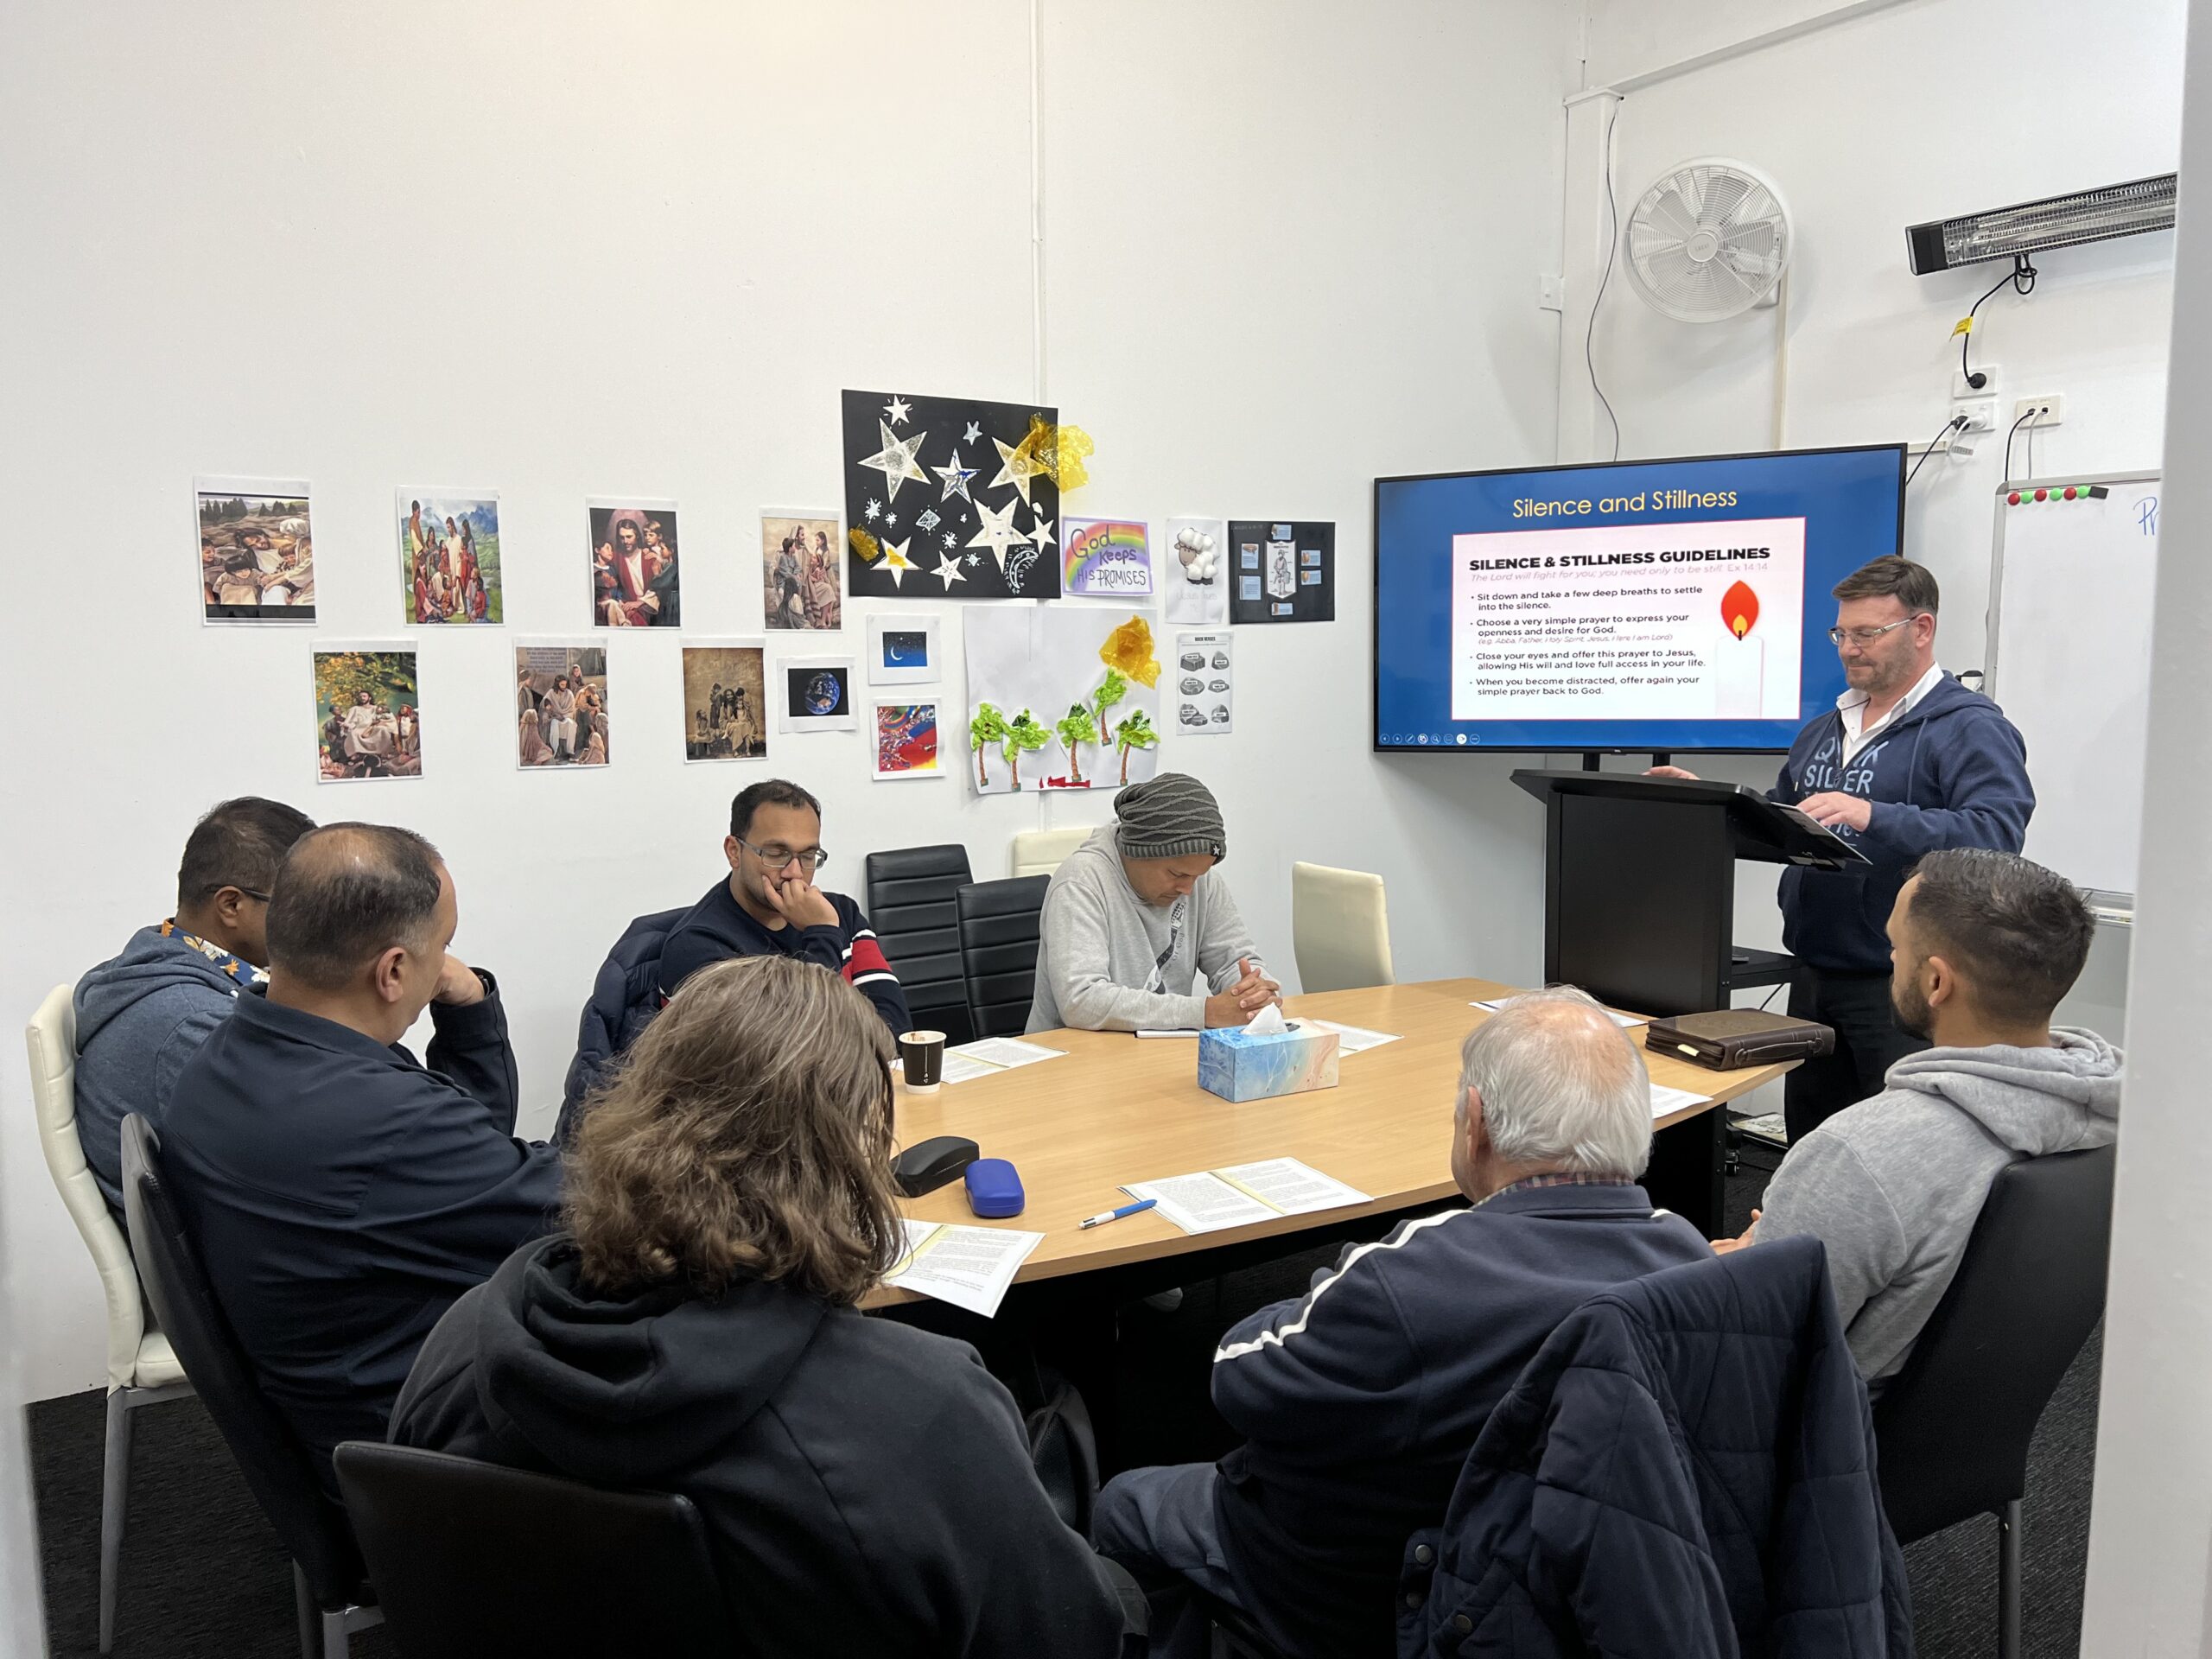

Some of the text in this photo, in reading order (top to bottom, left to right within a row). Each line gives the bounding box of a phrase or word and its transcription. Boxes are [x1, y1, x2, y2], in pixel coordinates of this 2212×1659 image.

[1513, 490, 1738, 518] Silence and Stillness
[1071, 524, 1116, 561] God
[1469, 548, 1770, 570] SILENCE & STILLNESS GUIDELINES
[1096, 569, 1146, 588] PROMISES
[1491, 573, 1513, 582] Lord
[1533, 571, 1556, 581] fight
[1559, 570, 1573, 579] for
[1599, 569, 1618, 579] you
[1620, 567, 1646, 575] need
[1649, 565, 1670, 575] only
[1674, 565, 1685, 574] to
[1688, 564, 1700, 574] be
[1727, 563, 1741, 572] Ex
[1592, 589, 1618, 598] deep
[1516, 601, 1551, 610] silence.
[1545, 616, 1576, 625] simple
[1478, 629, 1522, 638] openness
[1524, 627, 1542, 636] and
[1545, 626, 1574, 635] desire
[1503, 652, 1525, 661] your
[1618, 650, 1650, 658] prayer
[1665, 649, 1696, 658] Jesus,
[1478, 662, 1516, 671] allowing
[1688, 658, 1706, 667] life.
[1566, 677, 1618, 685] distracted,
[1620, 676, 1643, 684] offer
[1646, 676, 1674, 685] again
[1676, 677, 1700, 685] your
[1478, 688, 1508, 696] simple
[1510, 688, 1541, 696] prayer
[1804, 764, 1874, 794] SILER
